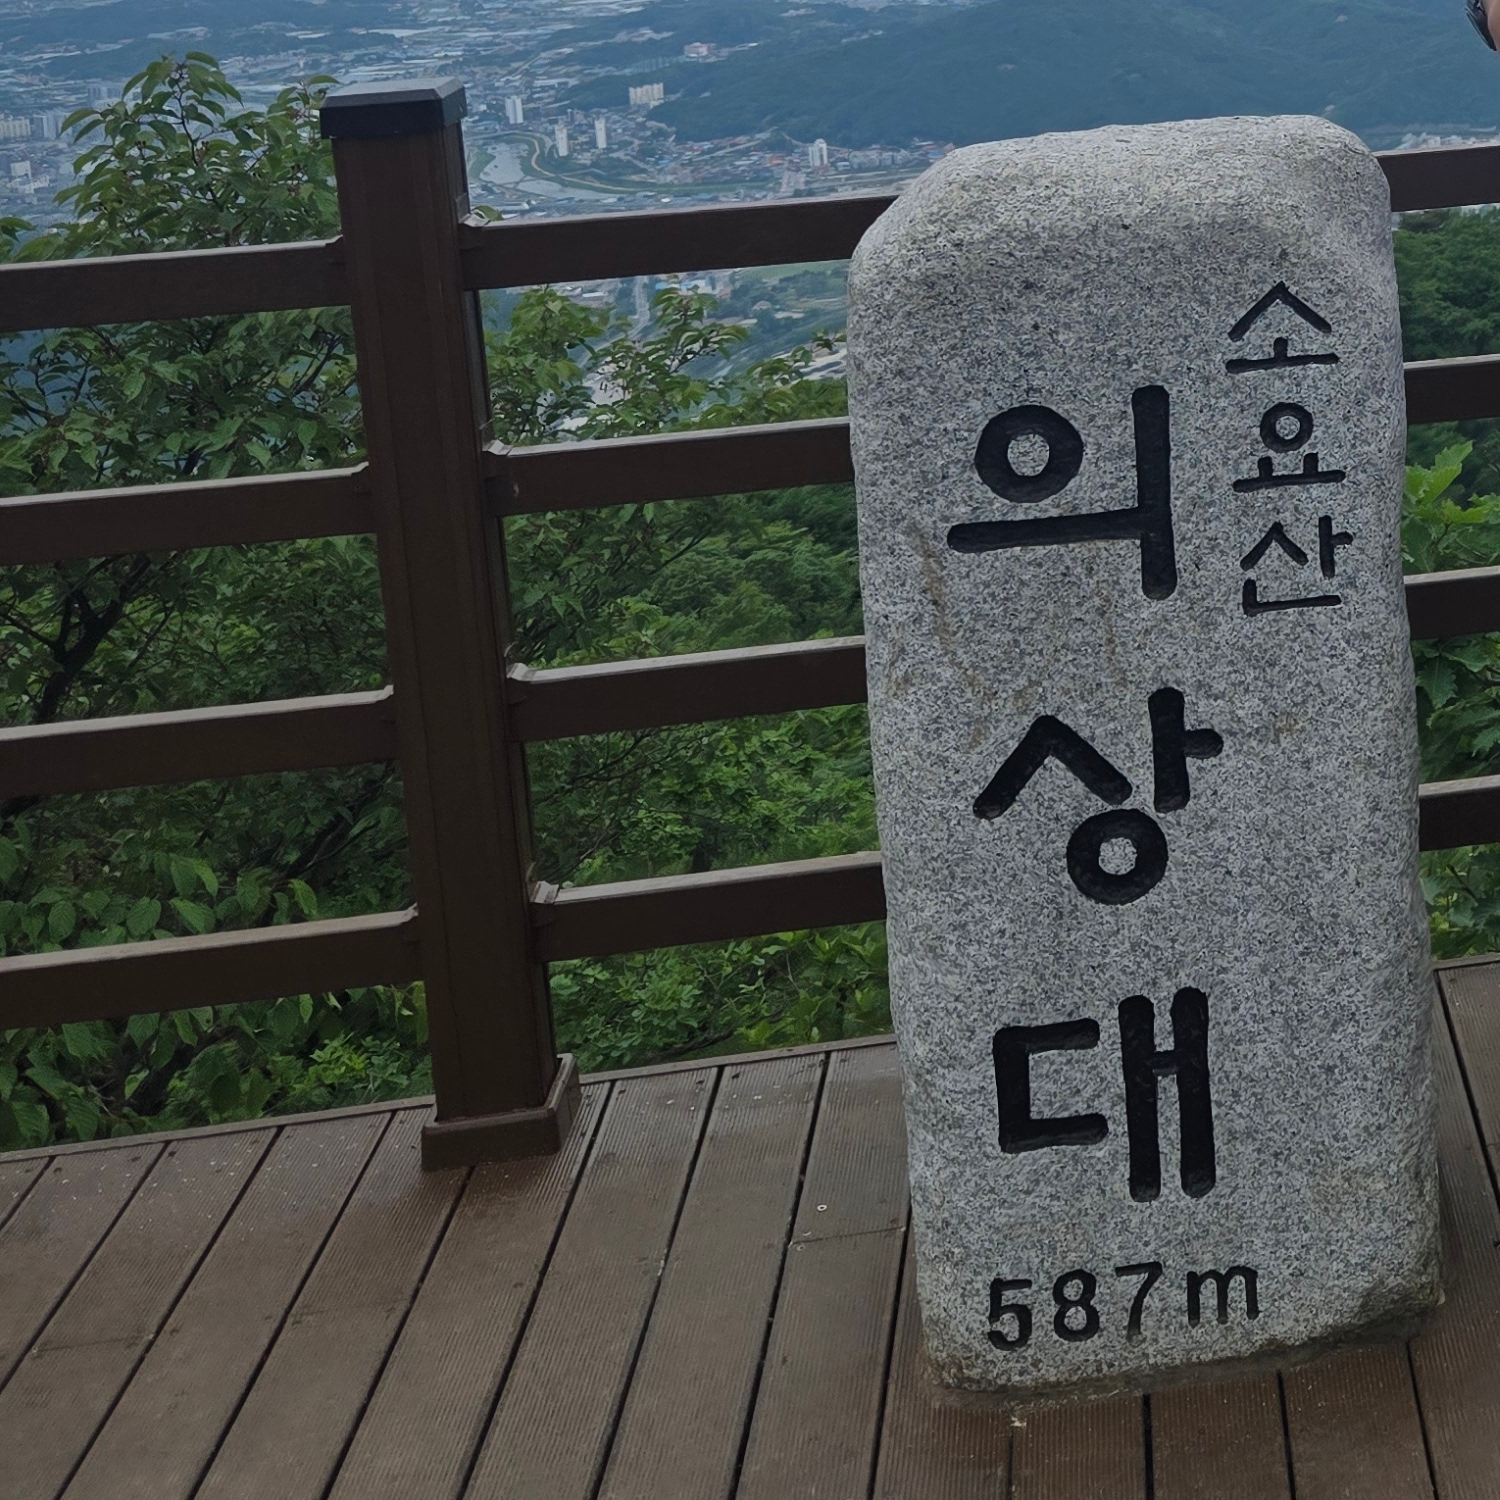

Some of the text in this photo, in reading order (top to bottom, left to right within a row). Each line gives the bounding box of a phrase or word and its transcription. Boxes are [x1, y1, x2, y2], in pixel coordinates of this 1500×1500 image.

[1226, 281, 1354, 617] 소요산
[946, 383, 1224, 1204] 의상대
[985, 1260, 1259, 1352] 587m
